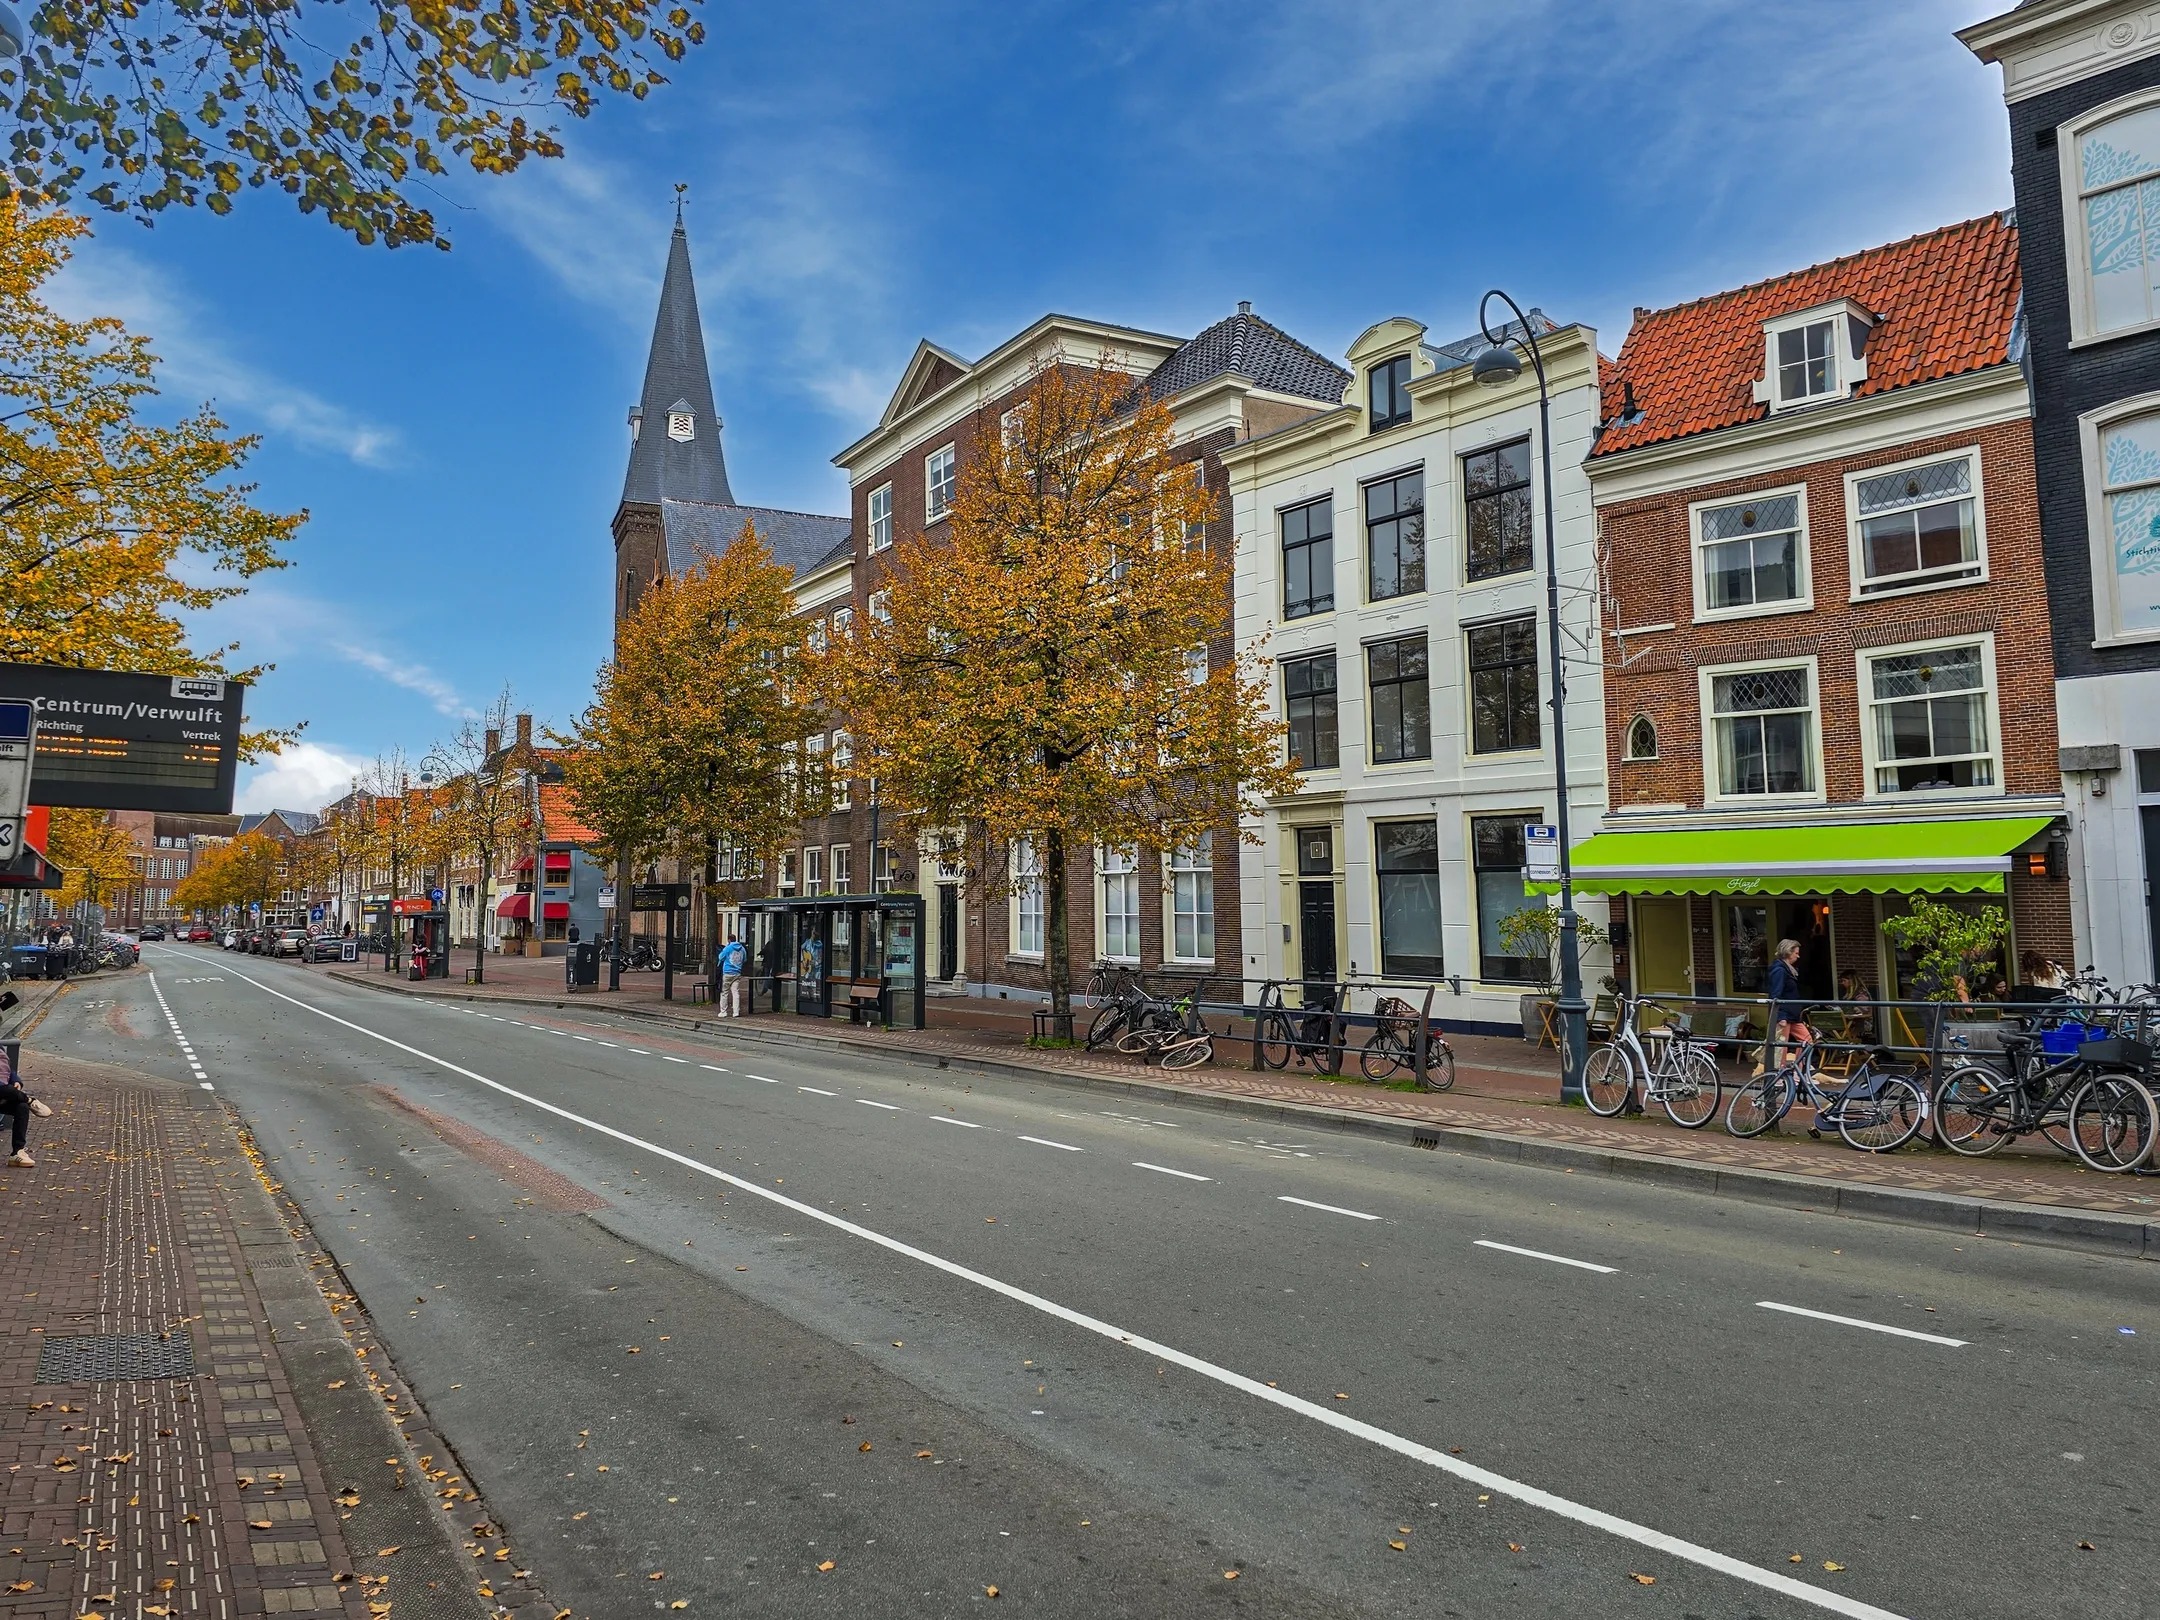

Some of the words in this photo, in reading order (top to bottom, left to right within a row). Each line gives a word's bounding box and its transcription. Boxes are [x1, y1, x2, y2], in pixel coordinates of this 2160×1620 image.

[34, 696, 223, 724] Centrum/Verwulft
[36, 719, 84, 733] Richting
[182, 730, 221, 741] Vertrek
[1726, 878, 1760, 892] Hazel
